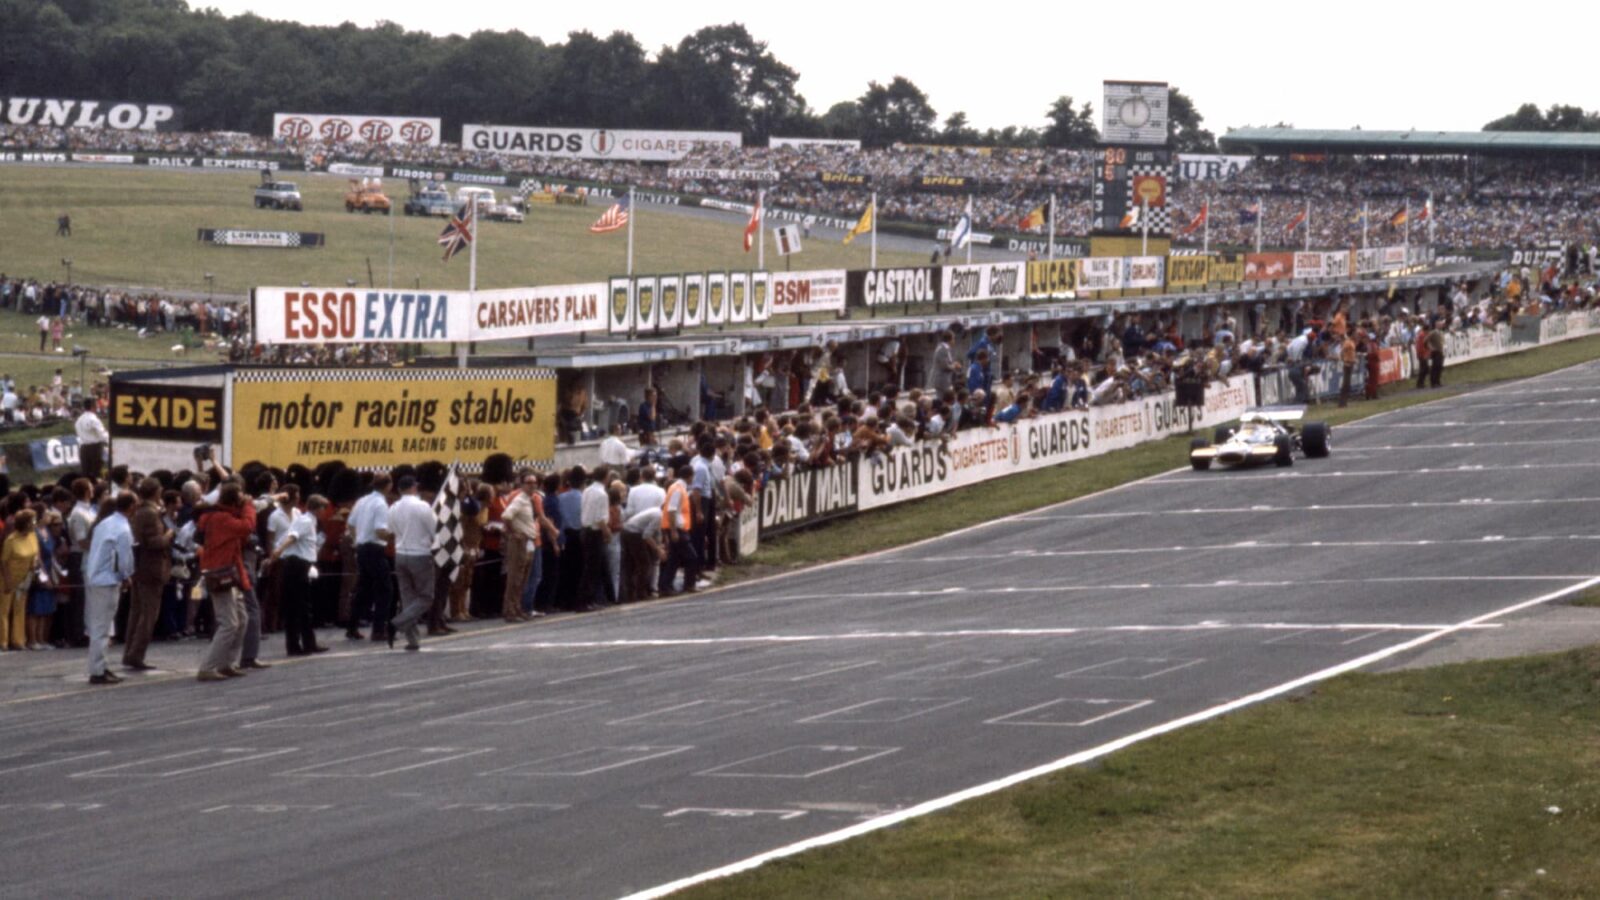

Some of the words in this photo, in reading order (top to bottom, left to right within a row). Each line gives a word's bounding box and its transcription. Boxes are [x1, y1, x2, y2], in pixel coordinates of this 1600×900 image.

[0, 97, 174, 131] UNLOP
[280, 119, 312, 138] STP
[321, 120, 351, 140] STP
[362, 121, 393, 141] STP
[401, 123, 432, 142] STP
[472, 130, 583, 152] GUARDS
[22, 153, 66, 162] NEWS
[149, 156, 195, 167] DAILY
[203, 158, 279, 170] EXPRESS
[1105, 149, 1126, 164] 80
[392, 168, 432, 179] FERODO
[1096, 166, 1103, 178] 1
[1095, 183, 1104, 195] 2
[1095, 200, 1103, 211] 3
[1094, 217, 1103, 228] 4
[1009, 239, 1048, 253] DAILY
[1053, 244, 1083, 256] MAIL
[1326, 251, 1349, 275] Shell
[1030, 259, 1076, 293] LUCAS
[774, 279, 810, 305] BSM
[864, 268, 934, 306] CASTROL
[284, 291, 356, 339] ESSO
[363, 292, 447, 339] EXTRA
[477, 297, 559, 329] CARSAVERS
[565, 294, 598, 321] PLAN
[731, 341, 737, 352] 2
[773, 337, 779, 347] 3
[816, 334, 823, 343] 4
[115, 394, 216, 430] EXIDE
[258, 393, 342, 430] motor
[354, 390, 438, 433] racing
[449, 388, 535, 425] stables
[1029, 417, 1090, 459] GUARDS
[1095, 412, 1142, 440] CIGARETTES
[46, 439, 80, 466] Gu
[297, 439, 394, 456] INTERNATIONAL
[402, 437, 447, 452] RACING
[455, 436, 499, 451] SCHOOL
[872, 447, 947, 495] GUARDS
[952, 438, 1008, 471] CIGARETTES
[763, 470, 812, 528] DAILY
[815, 461, 856, 514] MAIL
